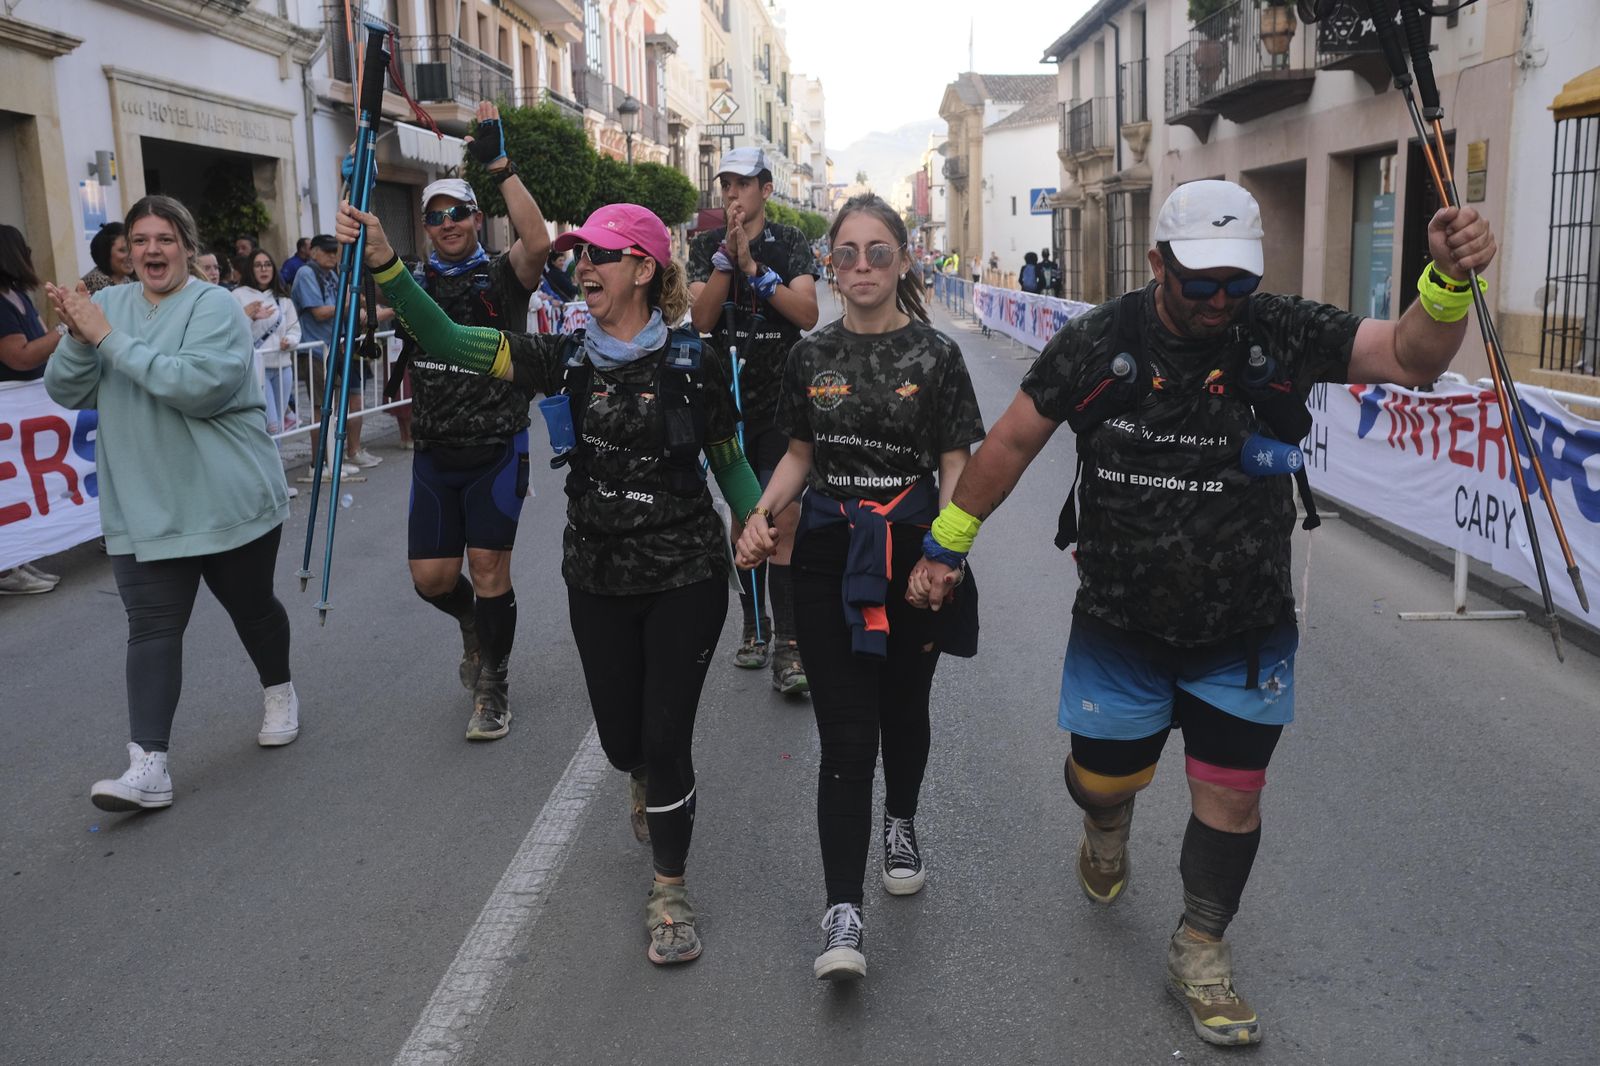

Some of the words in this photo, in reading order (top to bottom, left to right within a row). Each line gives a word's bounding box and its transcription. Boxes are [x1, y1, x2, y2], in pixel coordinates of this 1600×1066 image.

[147, 100, 193, 128] HOTEL
[425, 361, 459, 373] EDICIN
[1307, 383, 1328, 413] M
[581, 433, 608, 448] EGIÓN
[816, 432, 827, 442] LA
[828, 434, 862, 446] LEGIÓN
[864, 439, 883, 449] 101
[885, 442, 901, 454] KM
[1112, 418, 1153, 440] LEGN
[1154, 434, 1176, 442] 101
[1180, 434, 1197, 445] KM
[1218, 436, 1227, 446] H
[827, 474, 851, 486] XXIII
[854, 475, 902, 487] EDICIÓN
[904, 474, 921, 486] 20
[1097, 467, 1126, 483] XXIII
[1129, 476, 1186, 491] EDICIÓN
[625, 490, 654, 504] 2022
